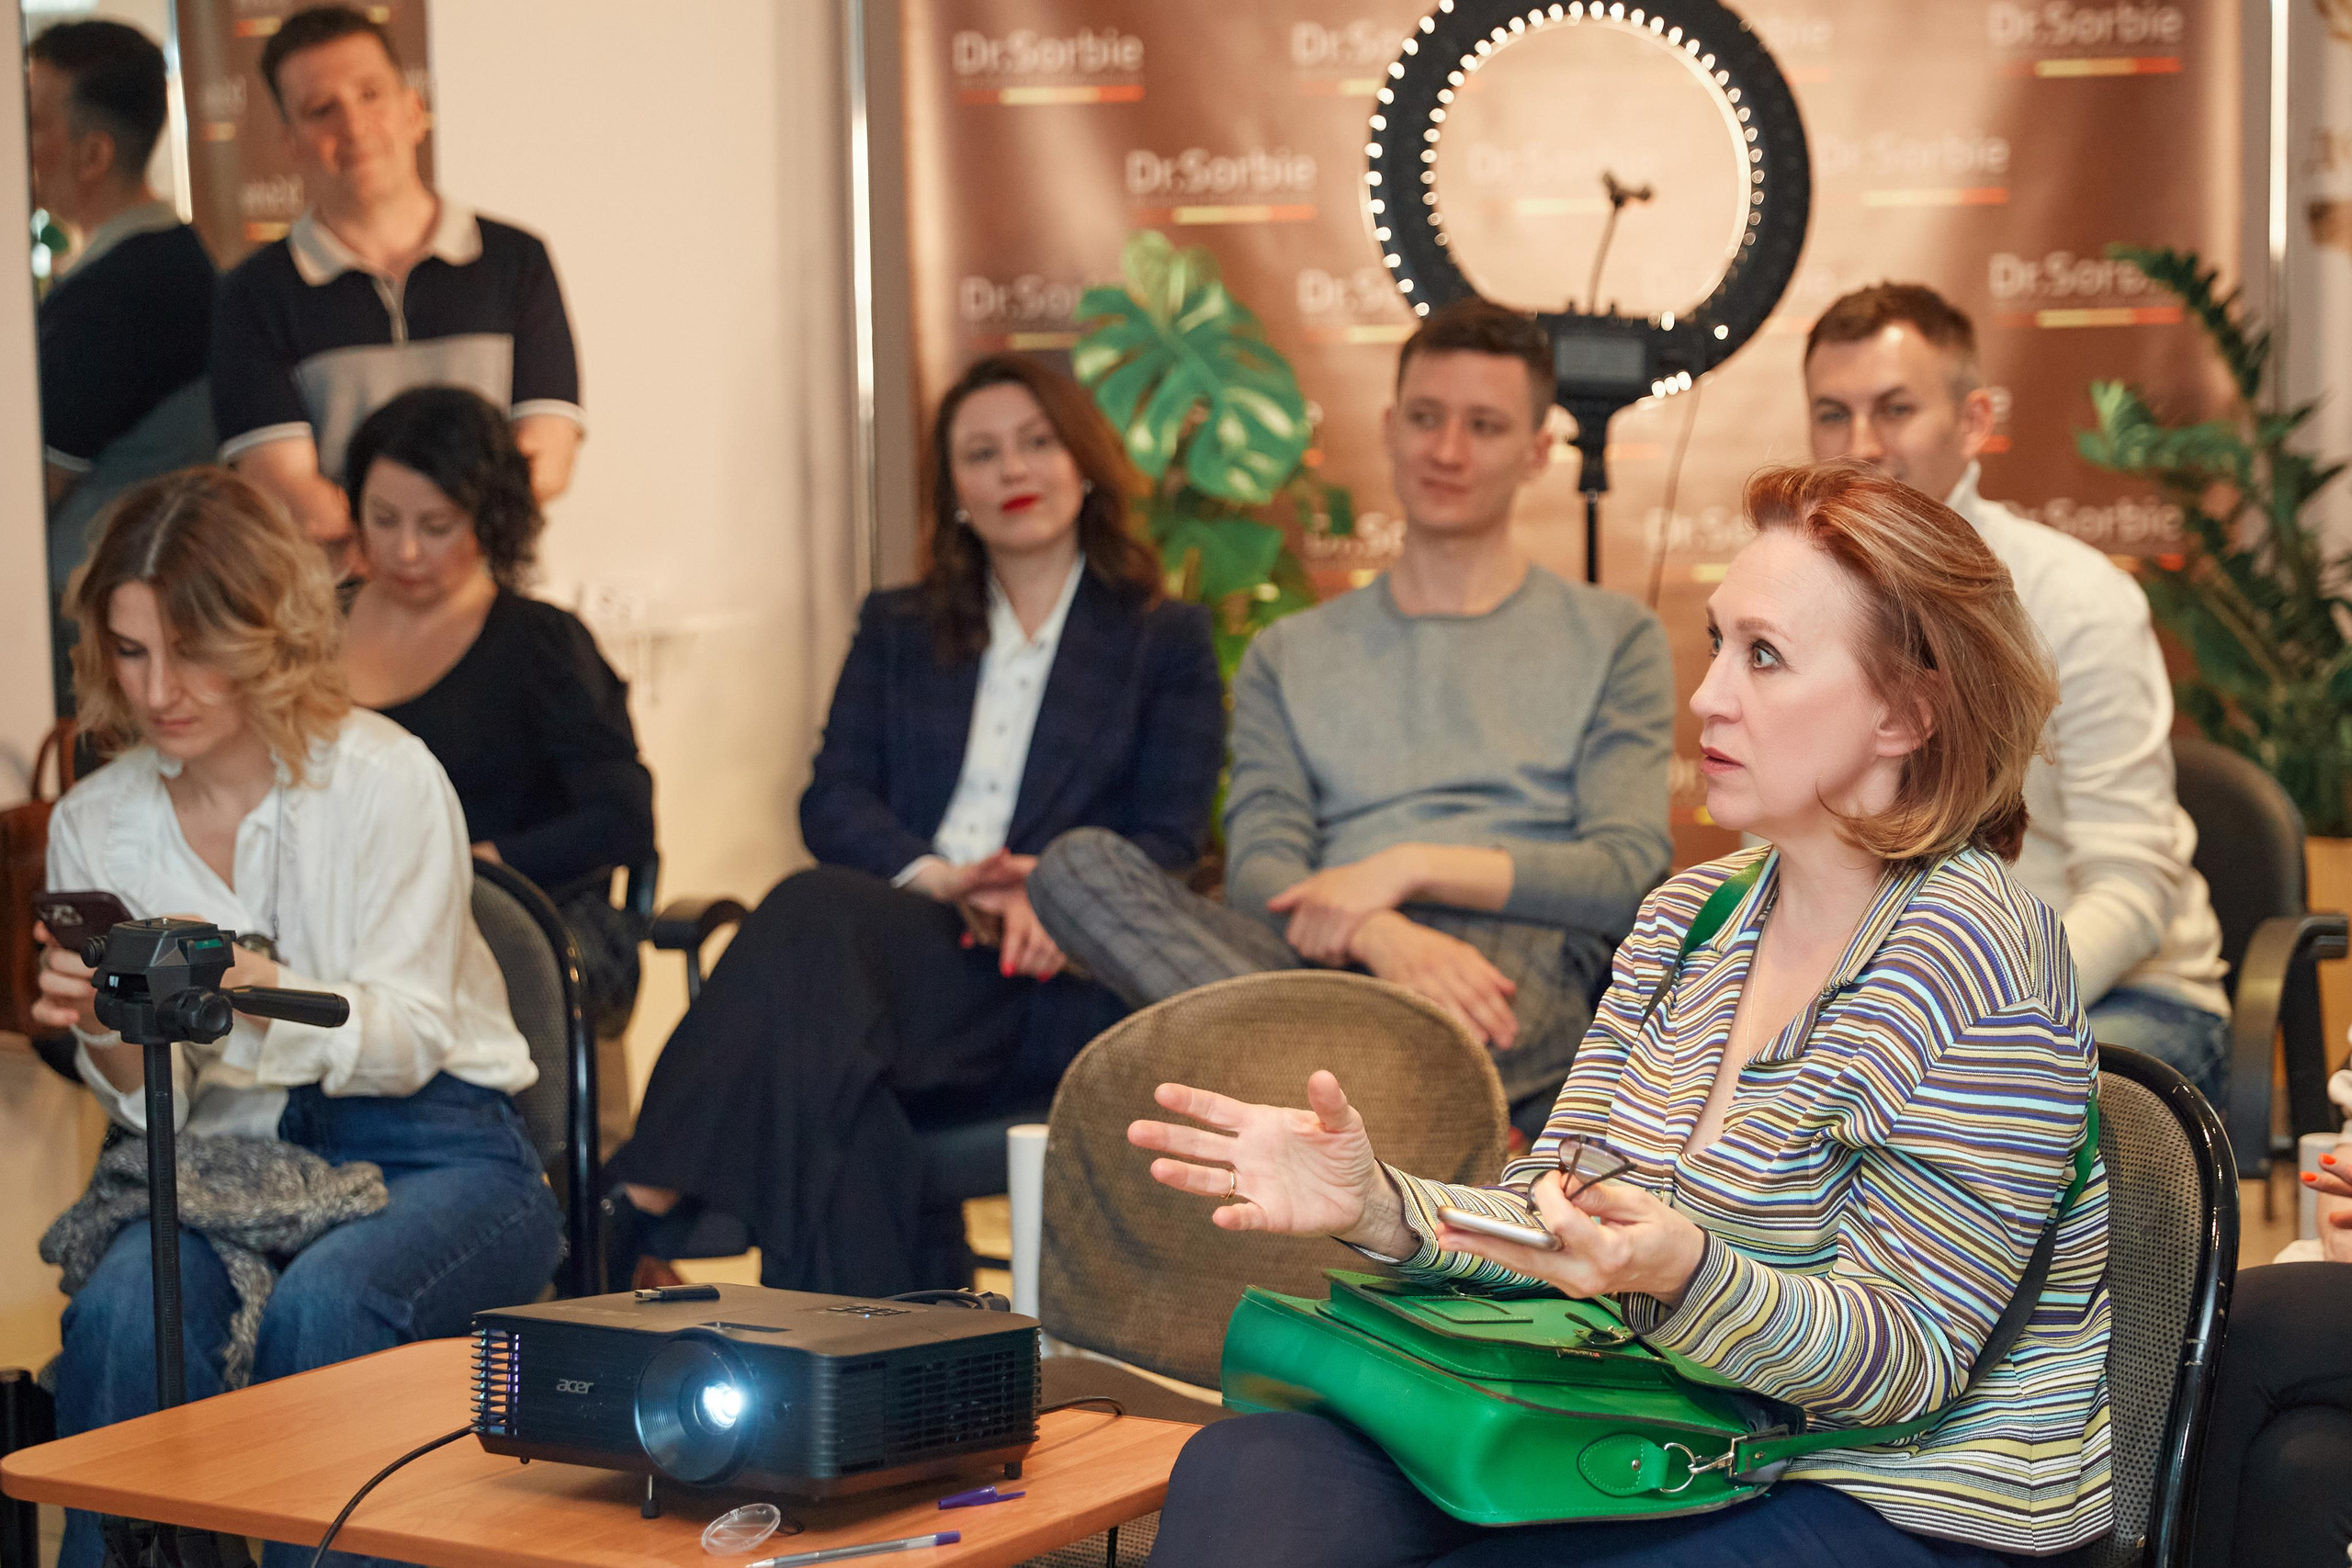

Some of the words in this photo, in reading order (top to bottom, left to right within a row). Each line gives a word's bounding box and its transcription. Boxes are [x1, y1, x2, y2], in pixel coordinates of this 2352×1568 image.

[1988, 4, 2184, 47] Dr.Sorbie
[953, 29, 1145, 74] Dr.Sorbie
[1125, 148, 1317, 193] Dr.Sorbie
[1816, 130, 2010, 176] Dr.Sorbie
[556, 1379, 594, 1394] acer
